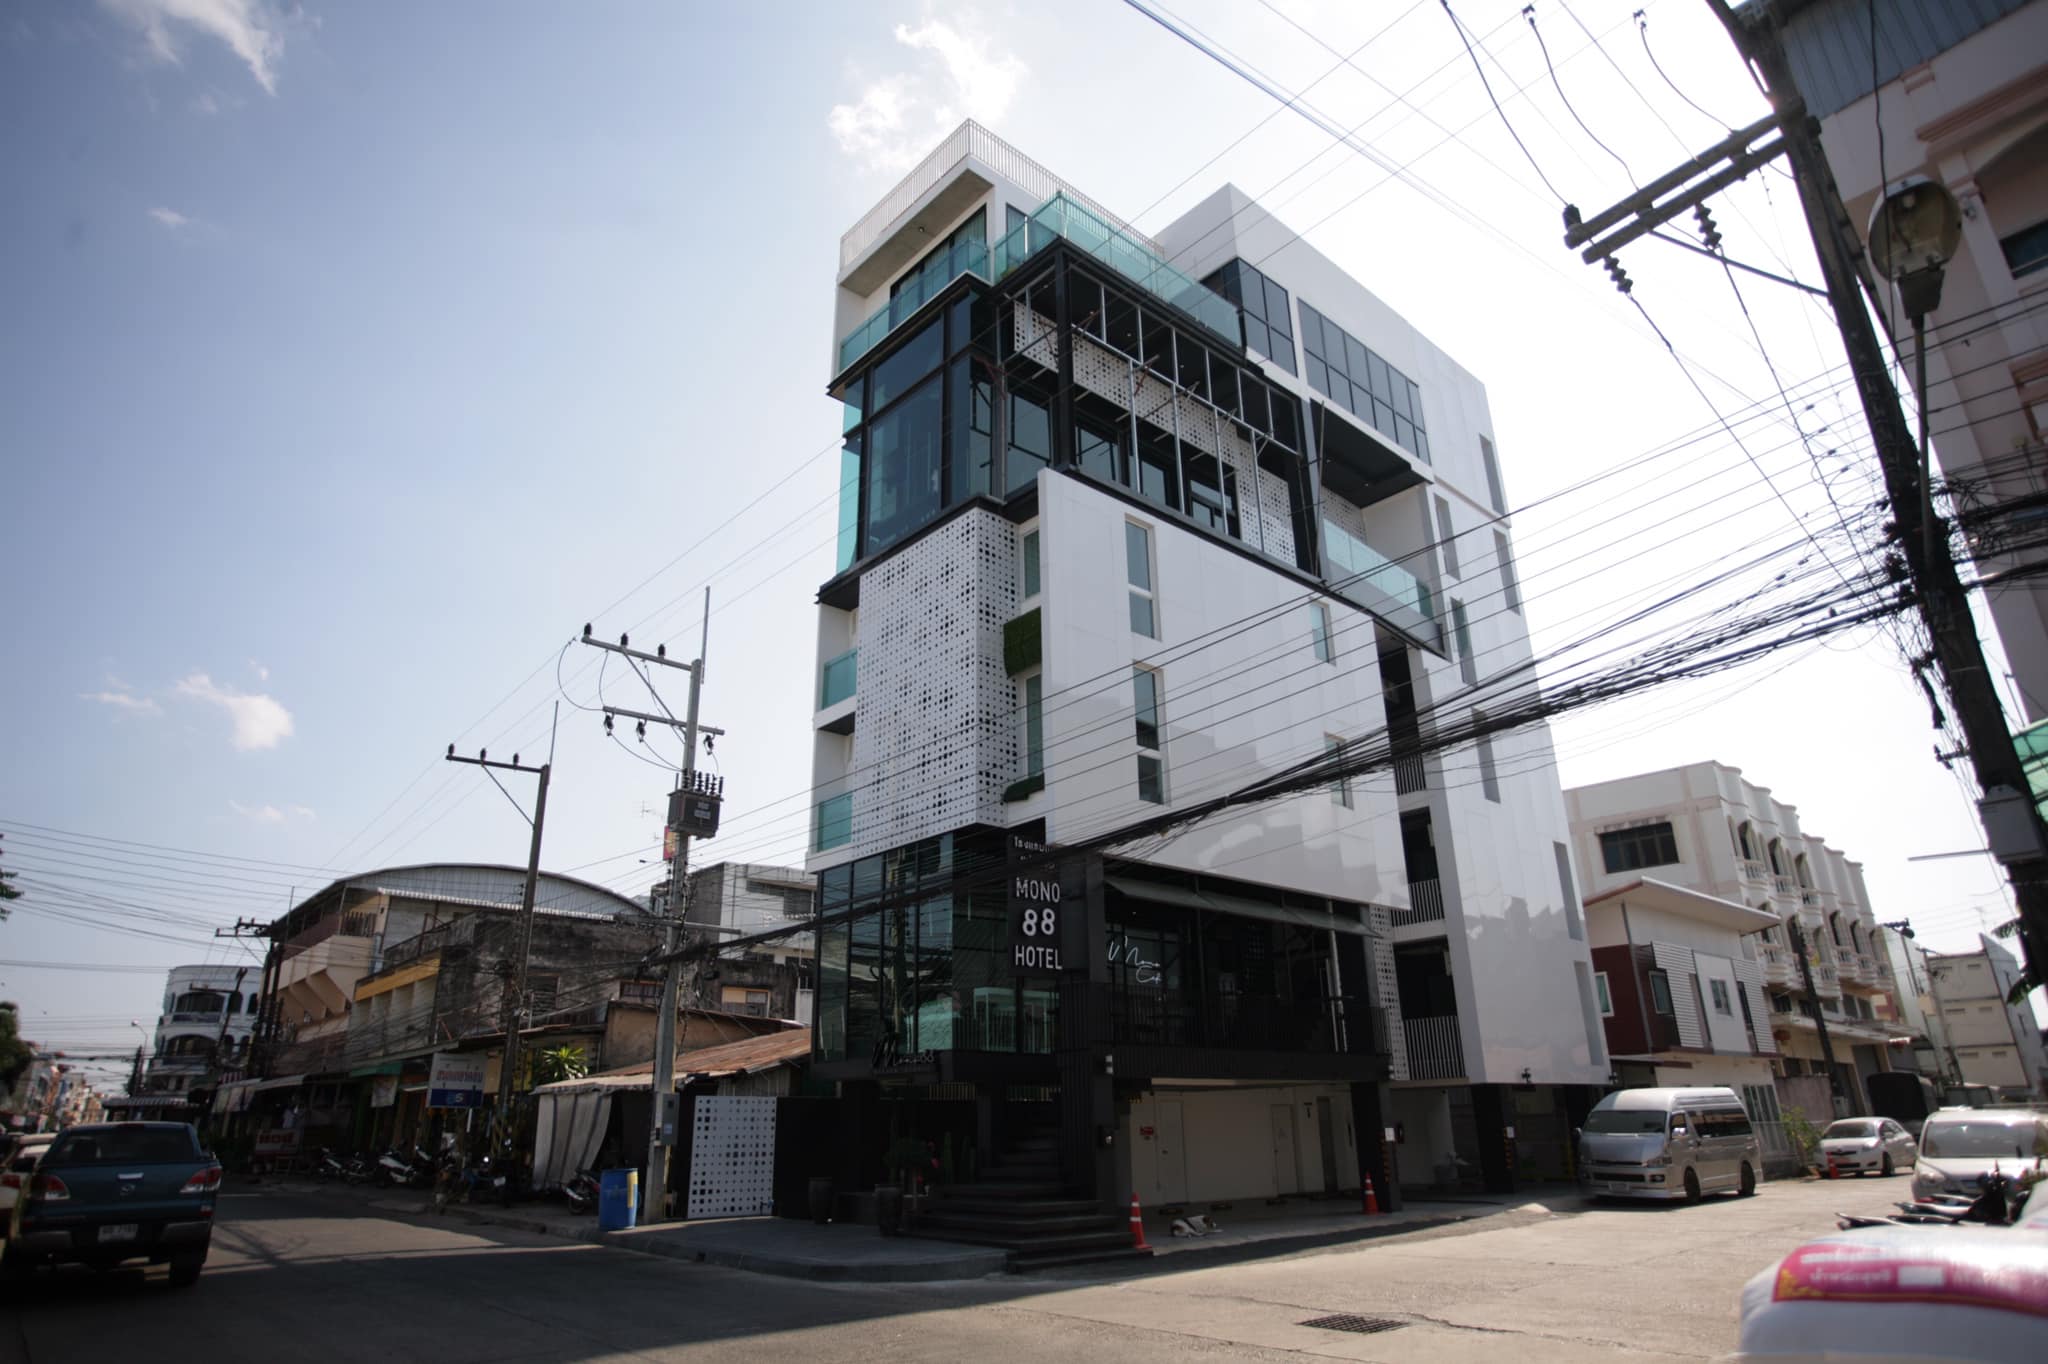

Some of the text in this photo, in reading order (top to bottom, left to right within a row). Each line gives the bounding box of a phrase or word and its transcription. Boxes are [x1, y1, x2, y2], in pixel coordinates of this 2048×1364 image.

[1016, 877, 1060, 903] MONO
[1022, 908, 1055, 937] 88
[1015, 945, 1062, 970] HOTEL
